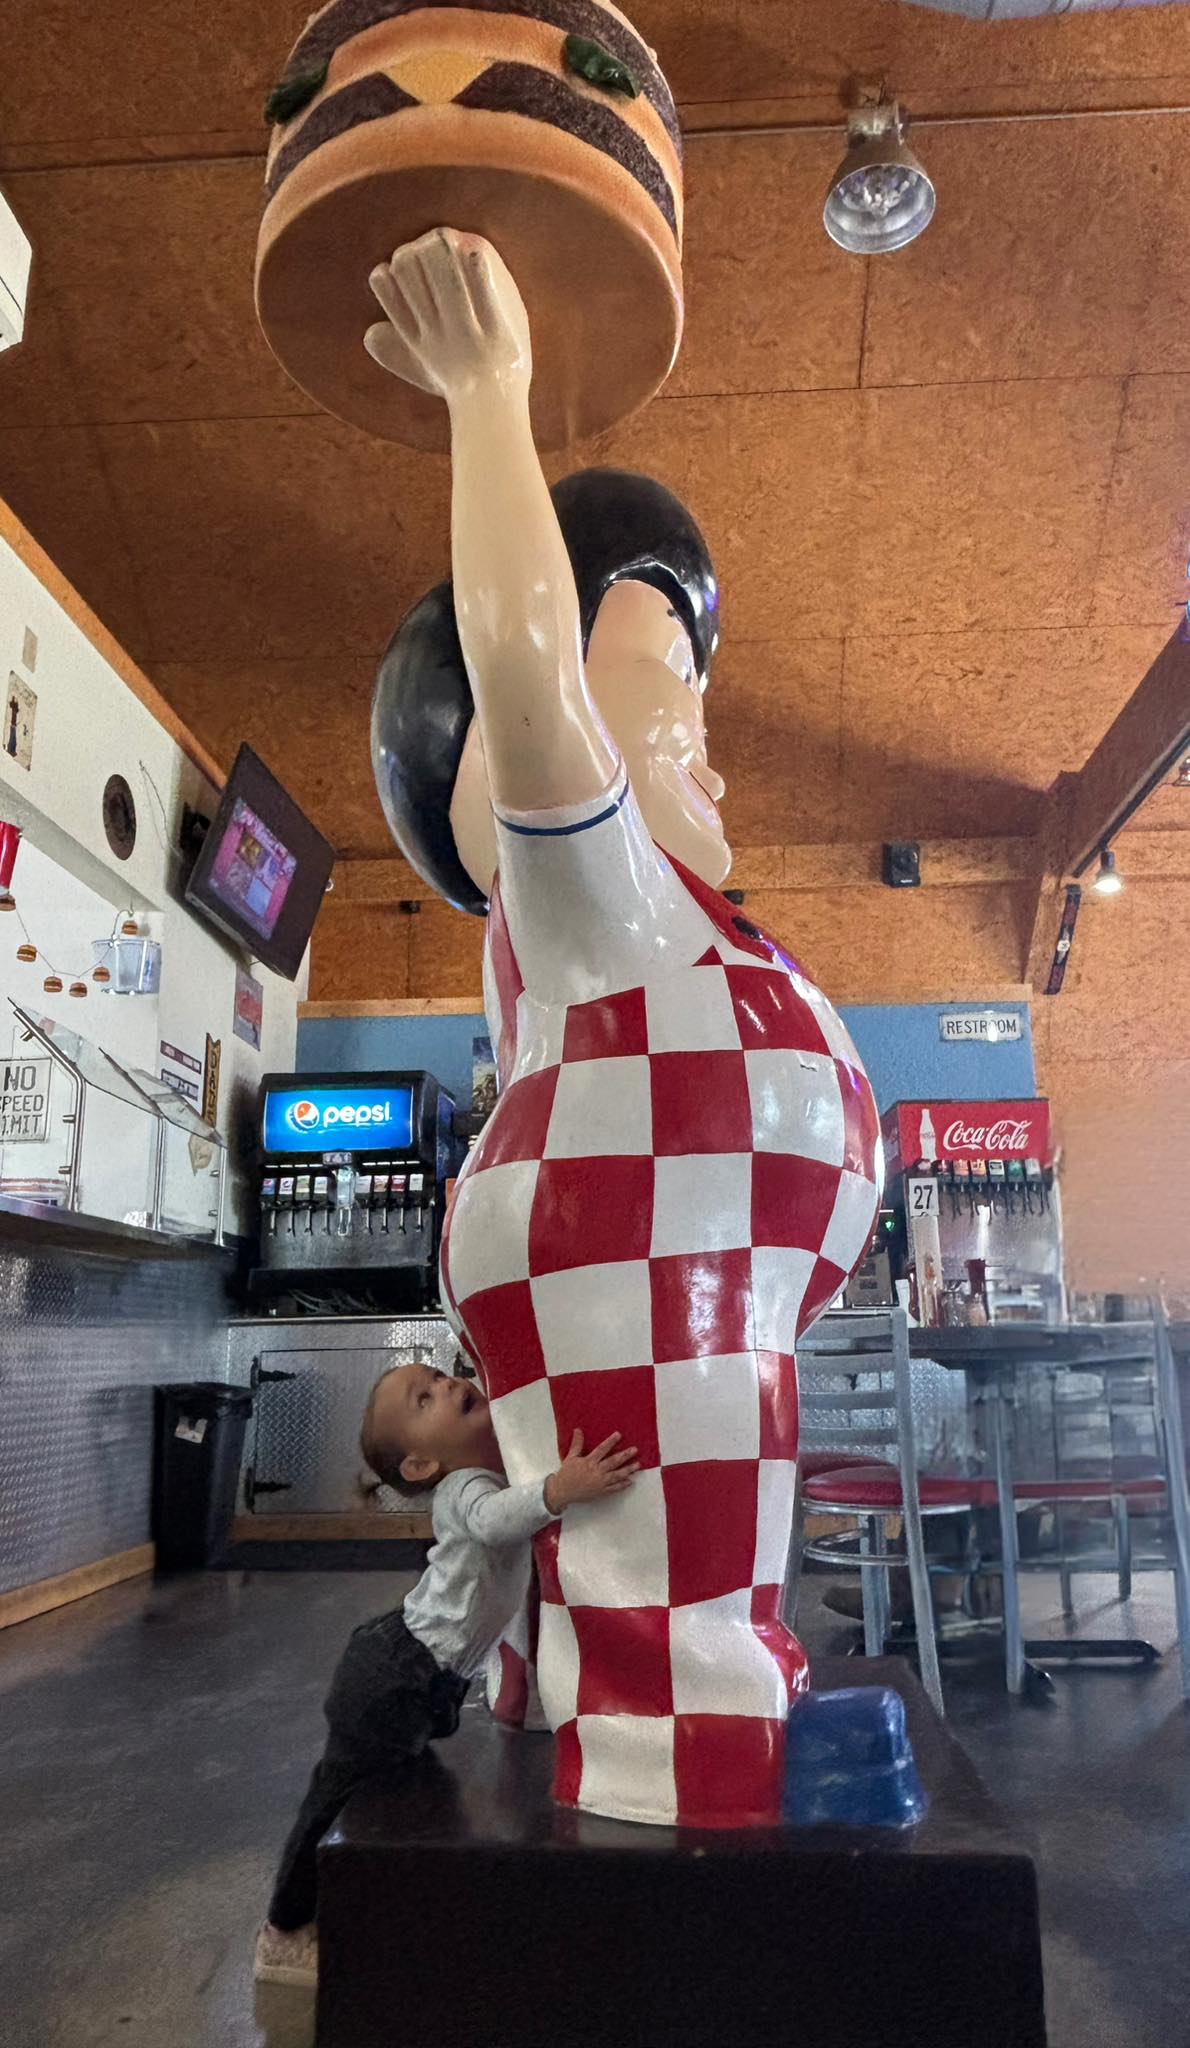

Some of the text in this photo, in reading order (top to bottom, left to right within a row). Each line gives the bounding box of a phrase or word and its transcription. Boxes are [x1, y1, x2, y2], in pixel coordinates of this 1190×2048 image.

[945, 1019, 1017, 1035] RESTROM
[3, 1066, 37, 1092] NO
[0, 1094, 44, 1114] PEED
[323, 1101, 391, 1129] pepsi
[0, 1113, 43, 1136] IMIT
[943, 1120, 1033, 1151] Coca-Cola
[913, 1185, 934, 1210] 27
